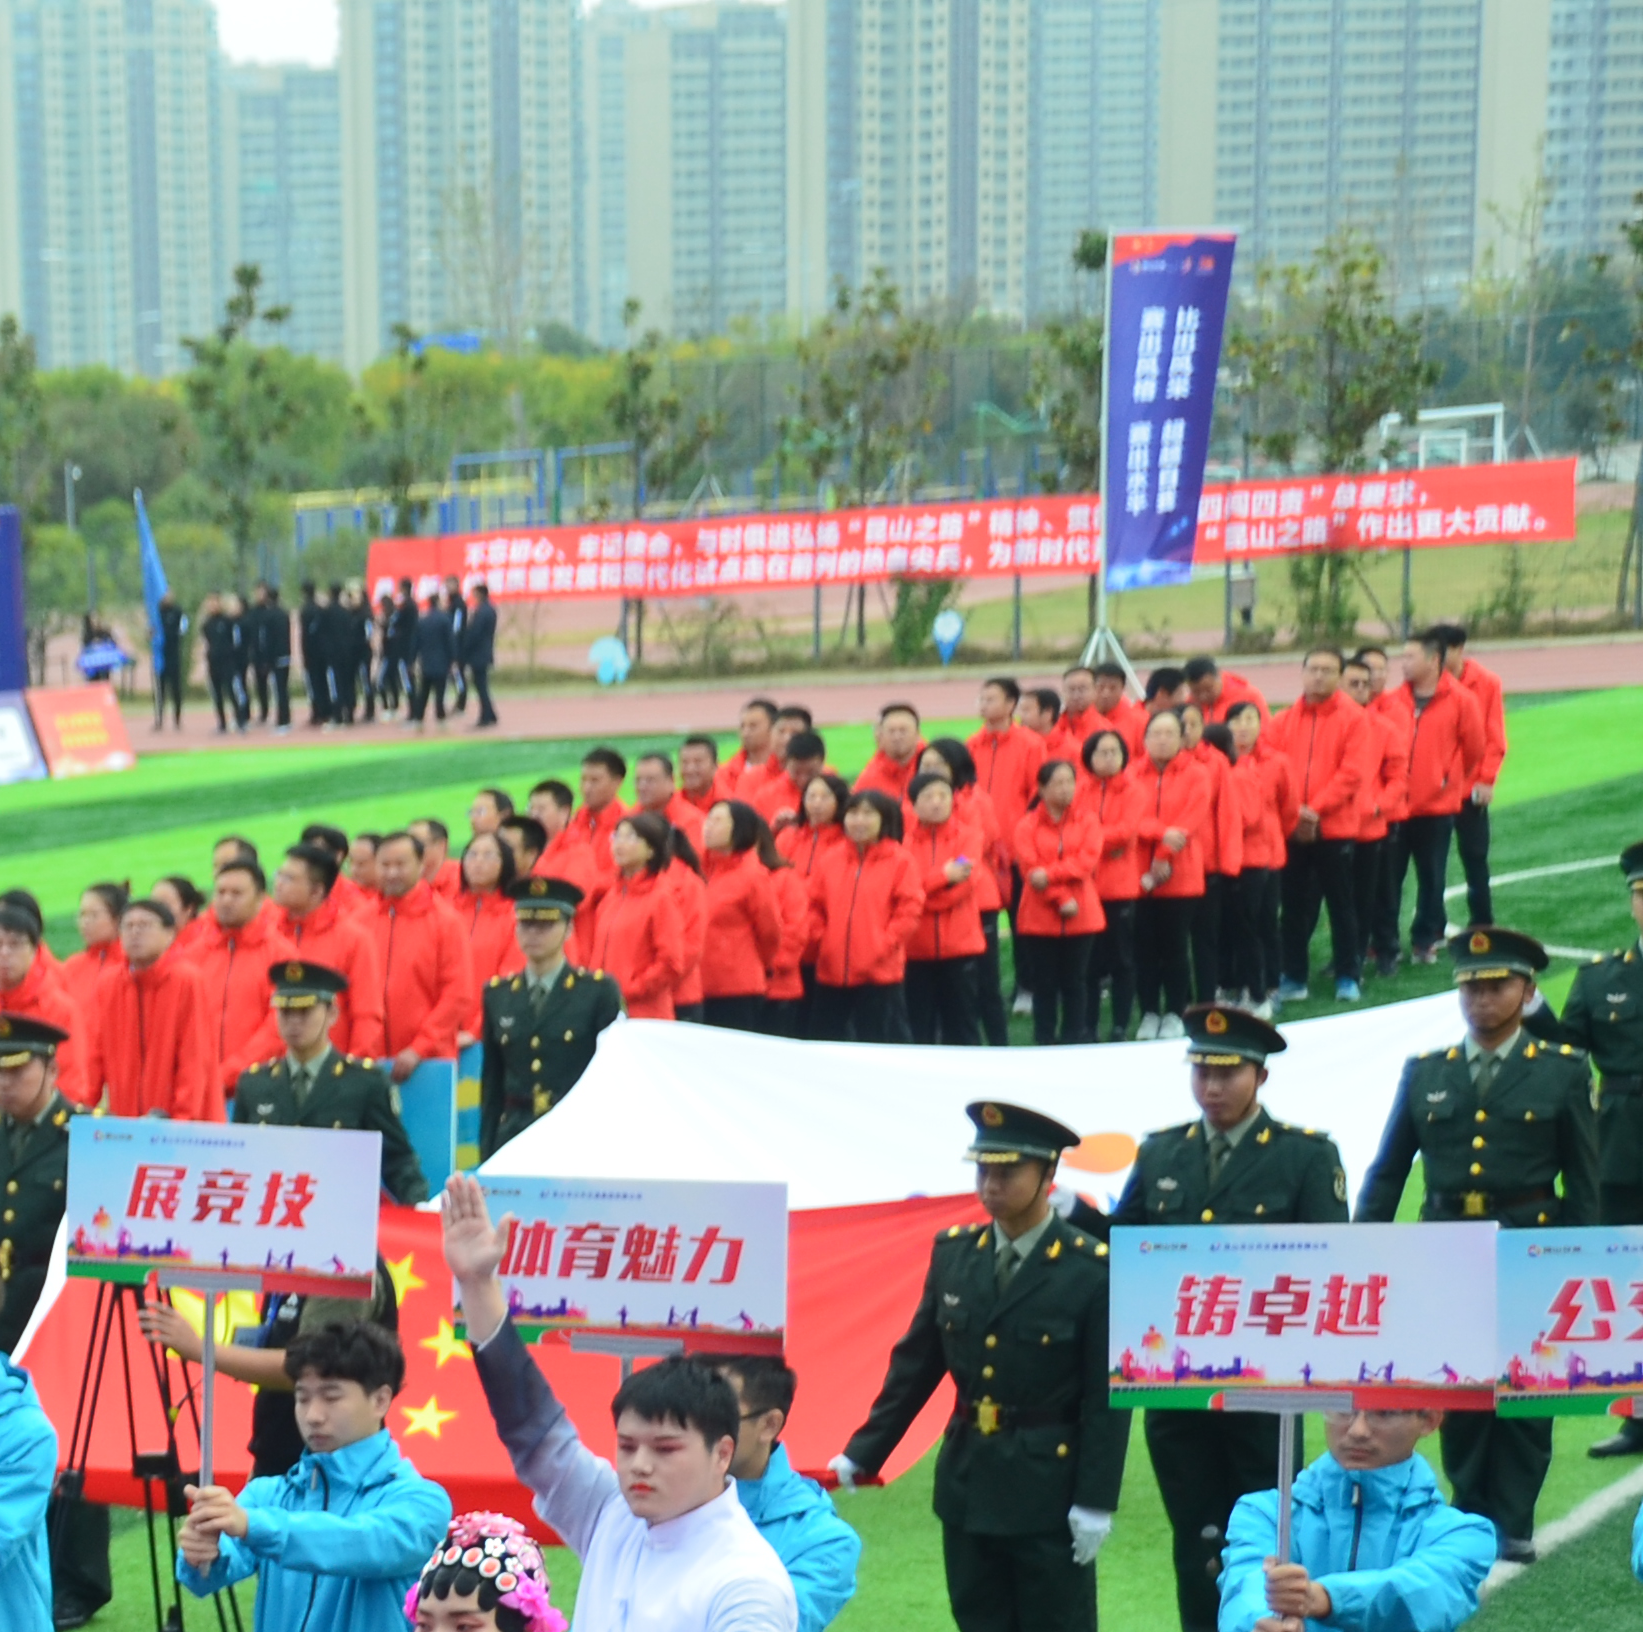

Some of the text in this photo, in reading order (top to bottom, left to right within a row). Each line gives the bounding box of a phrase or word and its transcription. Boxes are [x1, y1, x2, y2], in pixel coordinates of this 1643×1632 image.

[125, 1163, 318, 1230] 展竞技
[496, 1217, 745, 1286] 体育魅力
[1172, 1273, 1389, 1337] 铸卓越
[1544, 1277, 1643, 1342] 公
